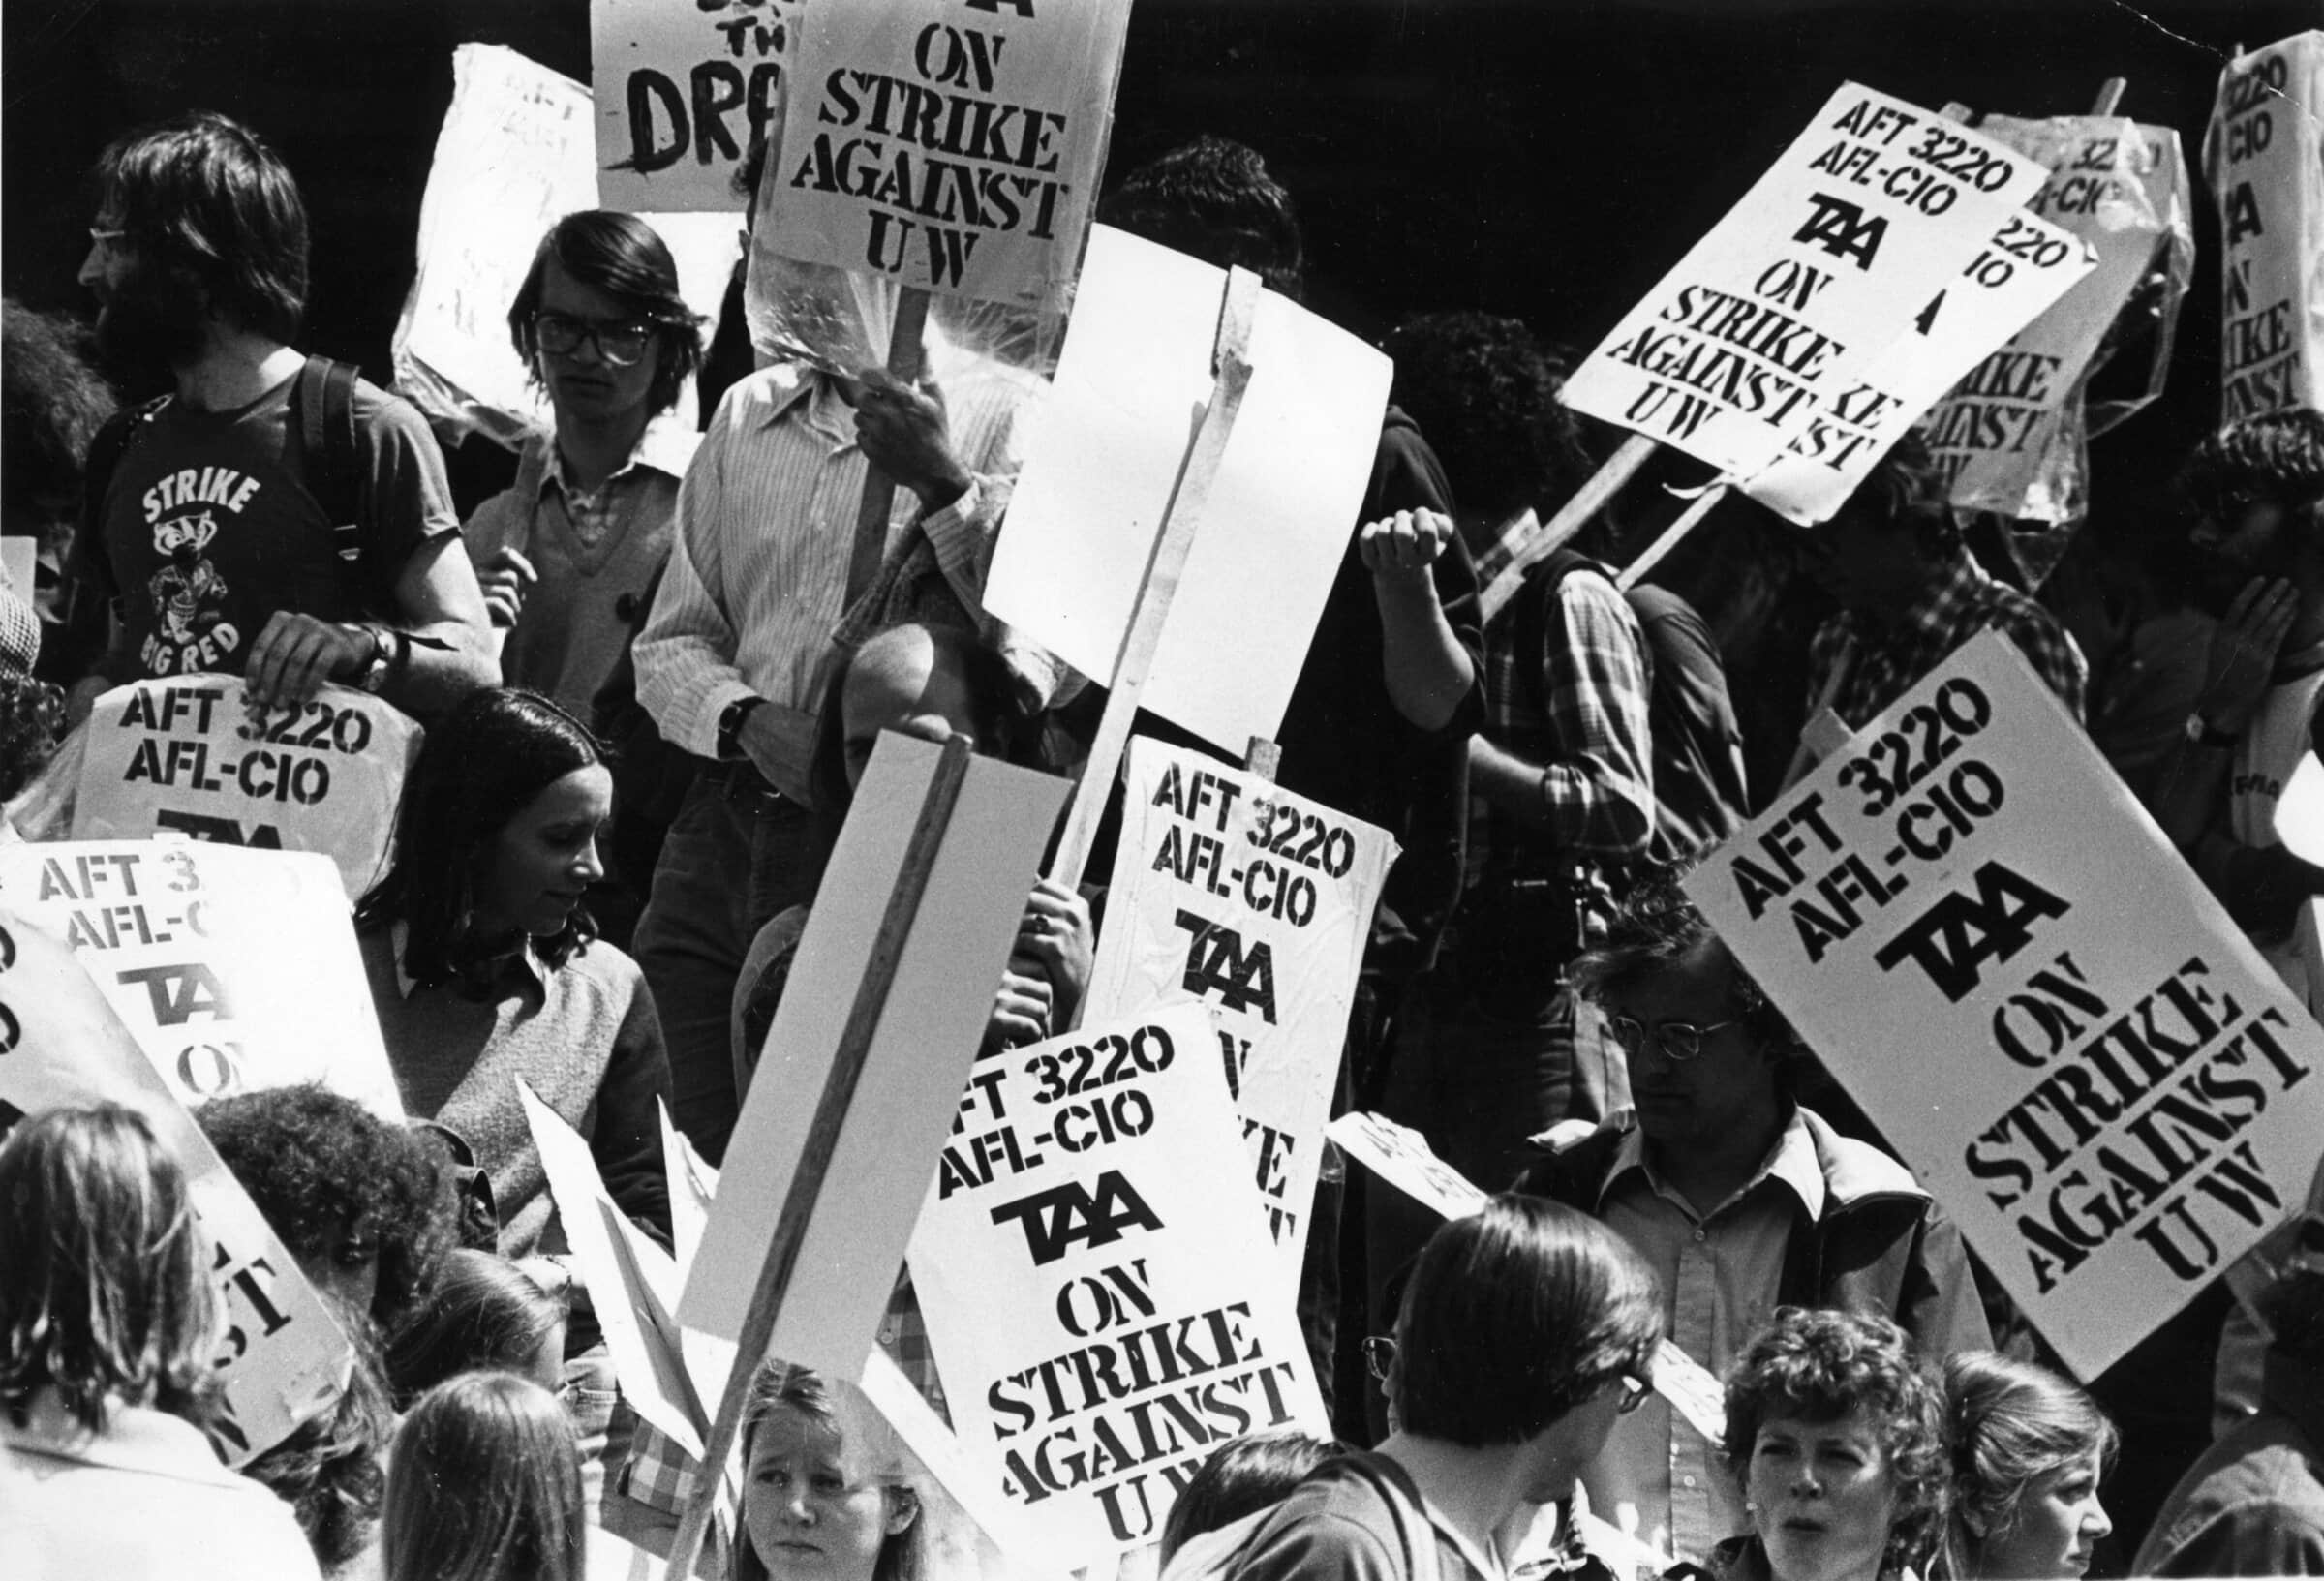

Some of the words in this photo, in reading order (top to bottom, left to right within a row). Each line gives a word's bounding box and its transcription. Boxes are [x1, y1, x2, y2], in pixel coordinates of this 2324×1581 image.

[915, 23, 1005, 92] ON
[819, 68, 1066, 173] STRIKE
[1833, 99, 1918, 146] AFT
[1908, 126, 2013, 193] 3220
[790, 133, 1070, 239] AGAINST
[1808, 140, 1958, 217] AFL-CIO
[1792, 192, 1889, 271] TAA
[1659, 284, 1845, 382] STRIKE
[1753, 258, 1834, 312] ON
[1606, 325, 1819, 428] AGAINST
[142, 466, 261, 524] STRIKE
[181, 622, 241, 674] RED
[119, 686, 224, 735] AFT
[122, 738, 331, 806] AFL-CIO
[1151, 761, 1241, 833] AFT
[1246, 797, 1356, 880] 3220
[1730, 792, 1843, 921] AFT
[1837, 677, 1992, 818] 3220
[39, 853, 141, 902] AFT
[1151, 825, 1317, 927] AFL-CIO
[1790, 760, 2005, 964] AFL-CIO
[1175, 907, 1277, 1026] TAA
[1873, 860, 2071, 1003] TAA
[1993, 951, 2109, 1070] ON
[1024, 1024, 1175, 1104] 3220
[1965, 956, 2243, 1212] STRIKE
[939, 1089, 1155, 1201] AFL-CIO
[2017, 1007, 2310, 1295] AGAINST
[989, 1169, 1165, 1267] TAA
[1056, 1258, 1156, 1338] ON
[987, 1301, 1264, 1441] STRIKE
[1002, 1361, 1296, 1505] AGAINST
